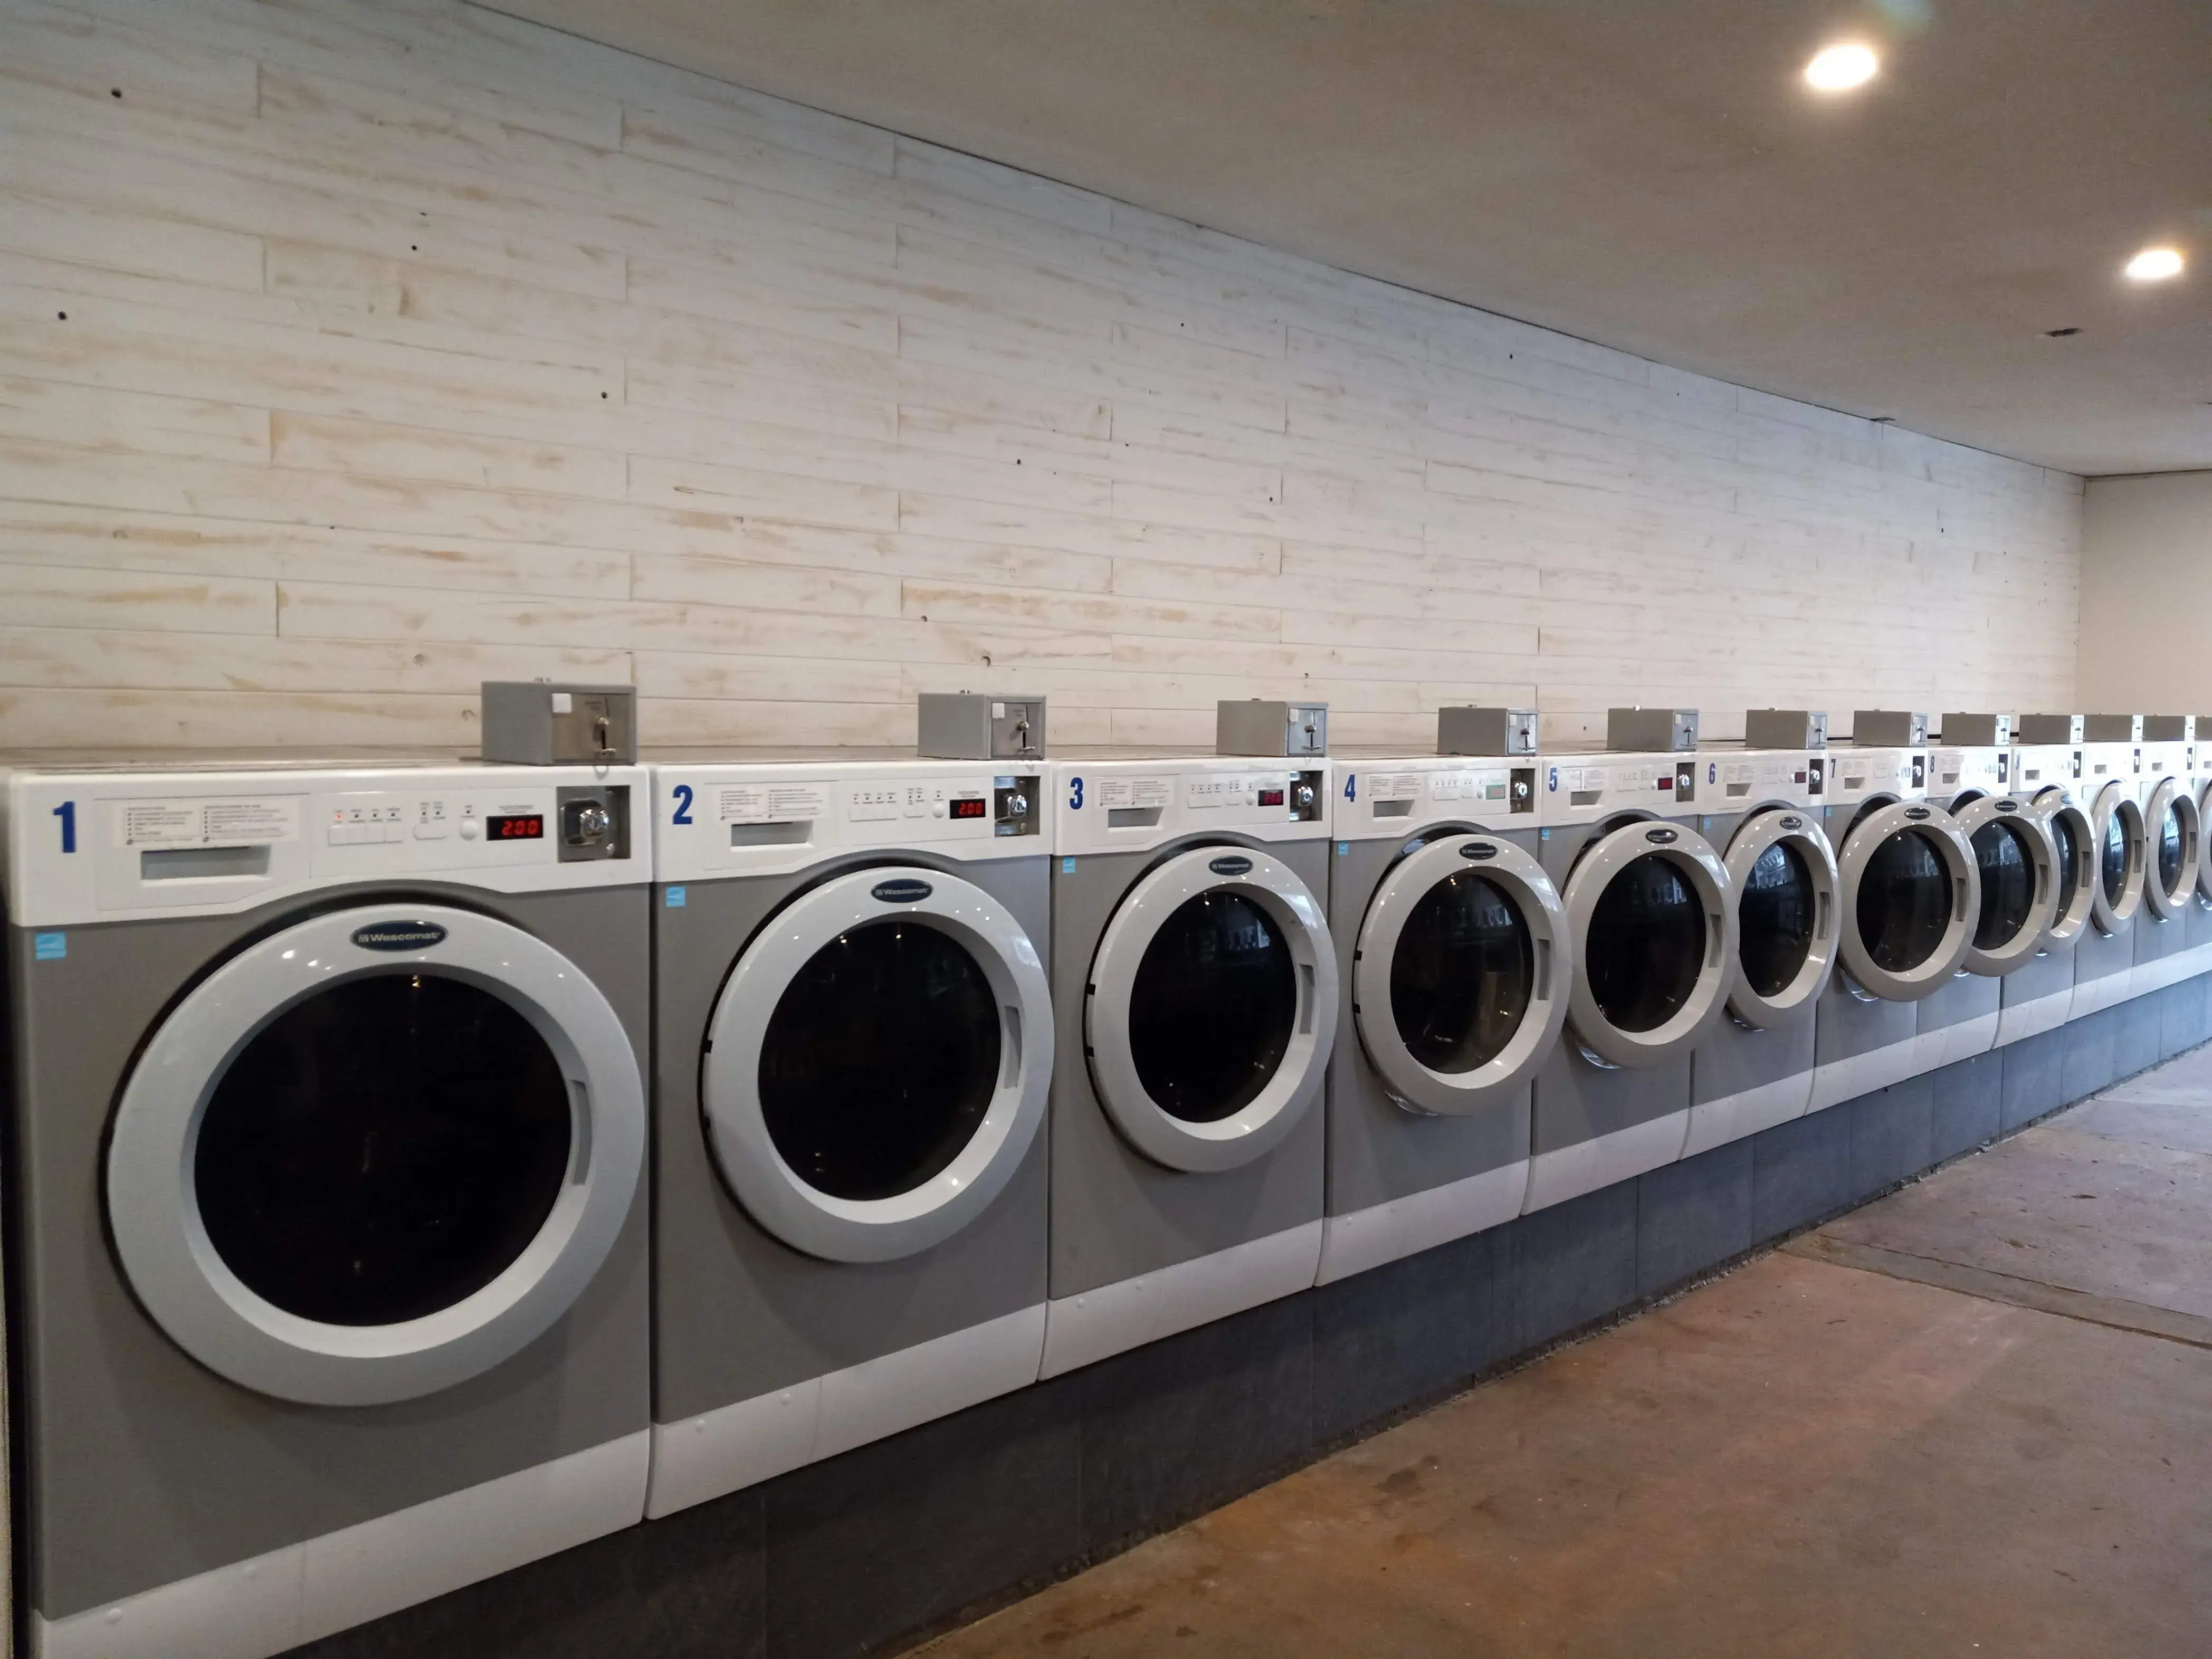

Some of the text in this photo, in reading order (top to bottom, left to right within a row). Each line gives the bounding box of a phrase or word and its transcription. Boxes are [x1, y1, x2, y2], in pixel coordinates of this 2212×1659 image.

[1709, 762, 1715, 785] 6
[1831, 758, 1836, 778] 7
[1930, 755, 1935, 773] 8
[1343, 774, 1356, 802] 4
[1549, 767, 1557, 792] 5
[672, 785, 693, 824] 2
[1069, 777, 1084, 810] 3
[53, 801, 76, 853] 1
